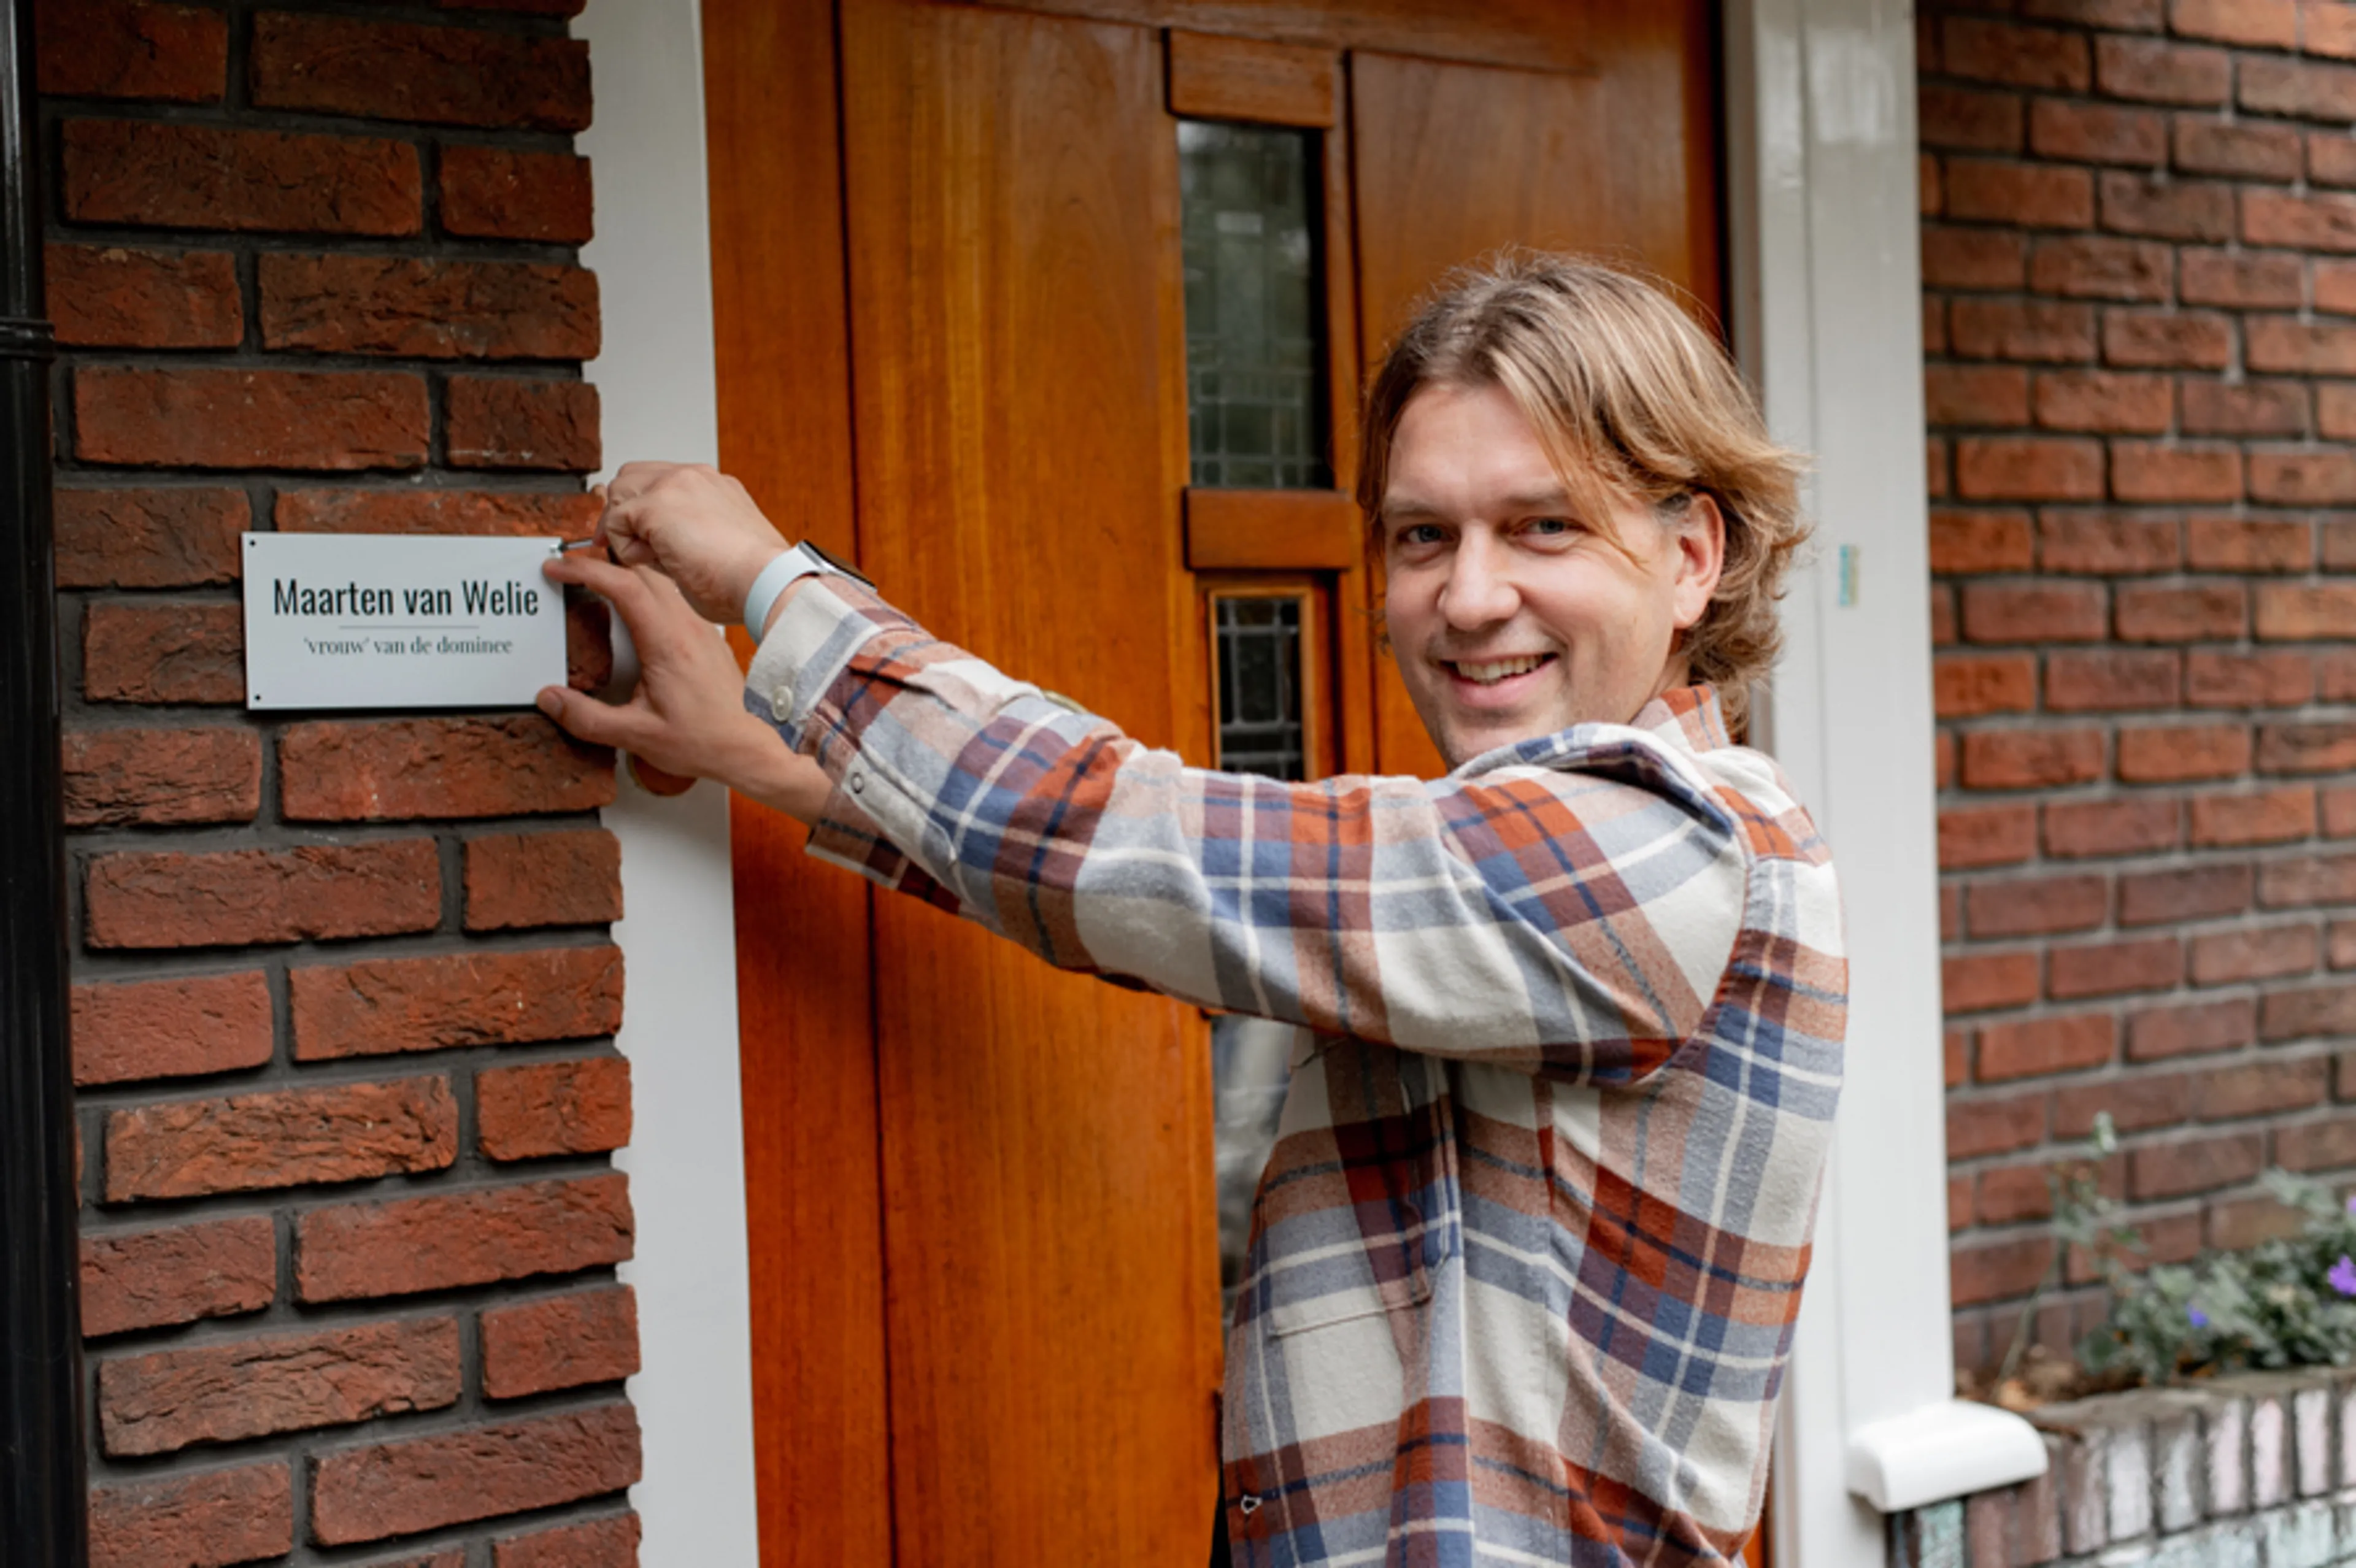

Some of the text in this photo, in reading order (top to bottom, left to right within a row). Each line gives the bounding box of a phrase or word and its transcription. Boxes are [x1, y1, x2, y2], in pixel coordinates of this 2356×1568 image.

[274, 578, 539, 616] Maarten van Welie
[373, 640, 406, 655] van
[410, 636, 433, 655] de
[436, 636, 513, 655] dominee
